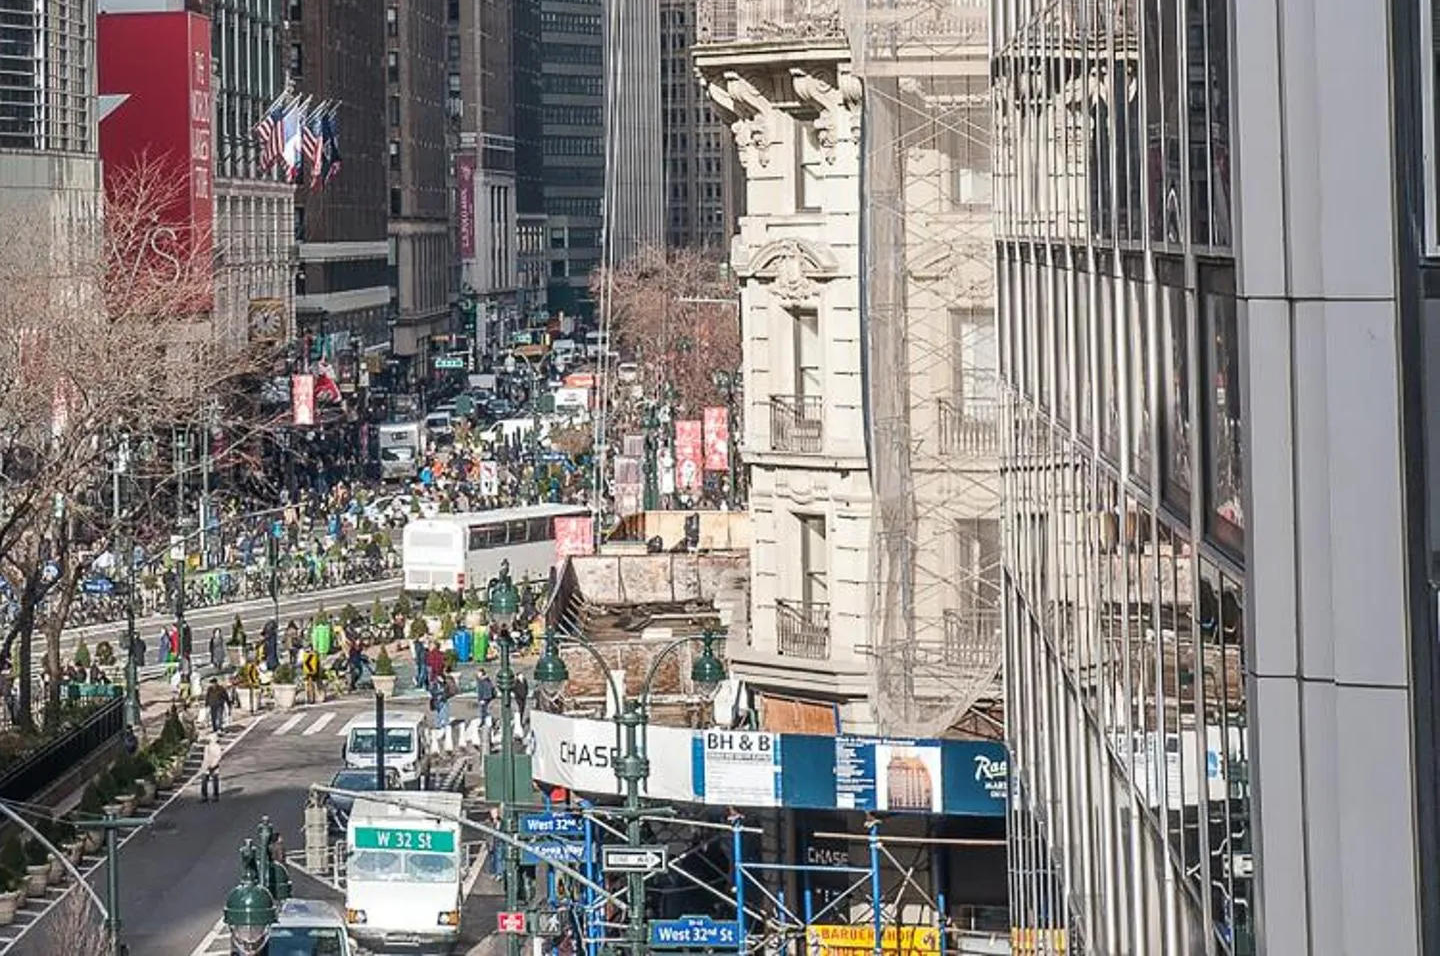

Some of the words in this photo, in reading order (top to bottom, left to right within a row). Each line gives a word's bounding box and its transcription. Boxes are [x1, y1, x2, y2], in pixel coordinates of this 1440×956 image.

[708, 733, 733, 750] BH
[739, 734, 753, 751] &
[758, 735, 771, 751] B
[527, 819, 553, 831] West
[377, 831, 389, 847] W
[394, 832, 412, 848] 32
[417, 833, 432, 850] St
[659, 928, 690, 942] West
[719, 928, 733, 942] St
